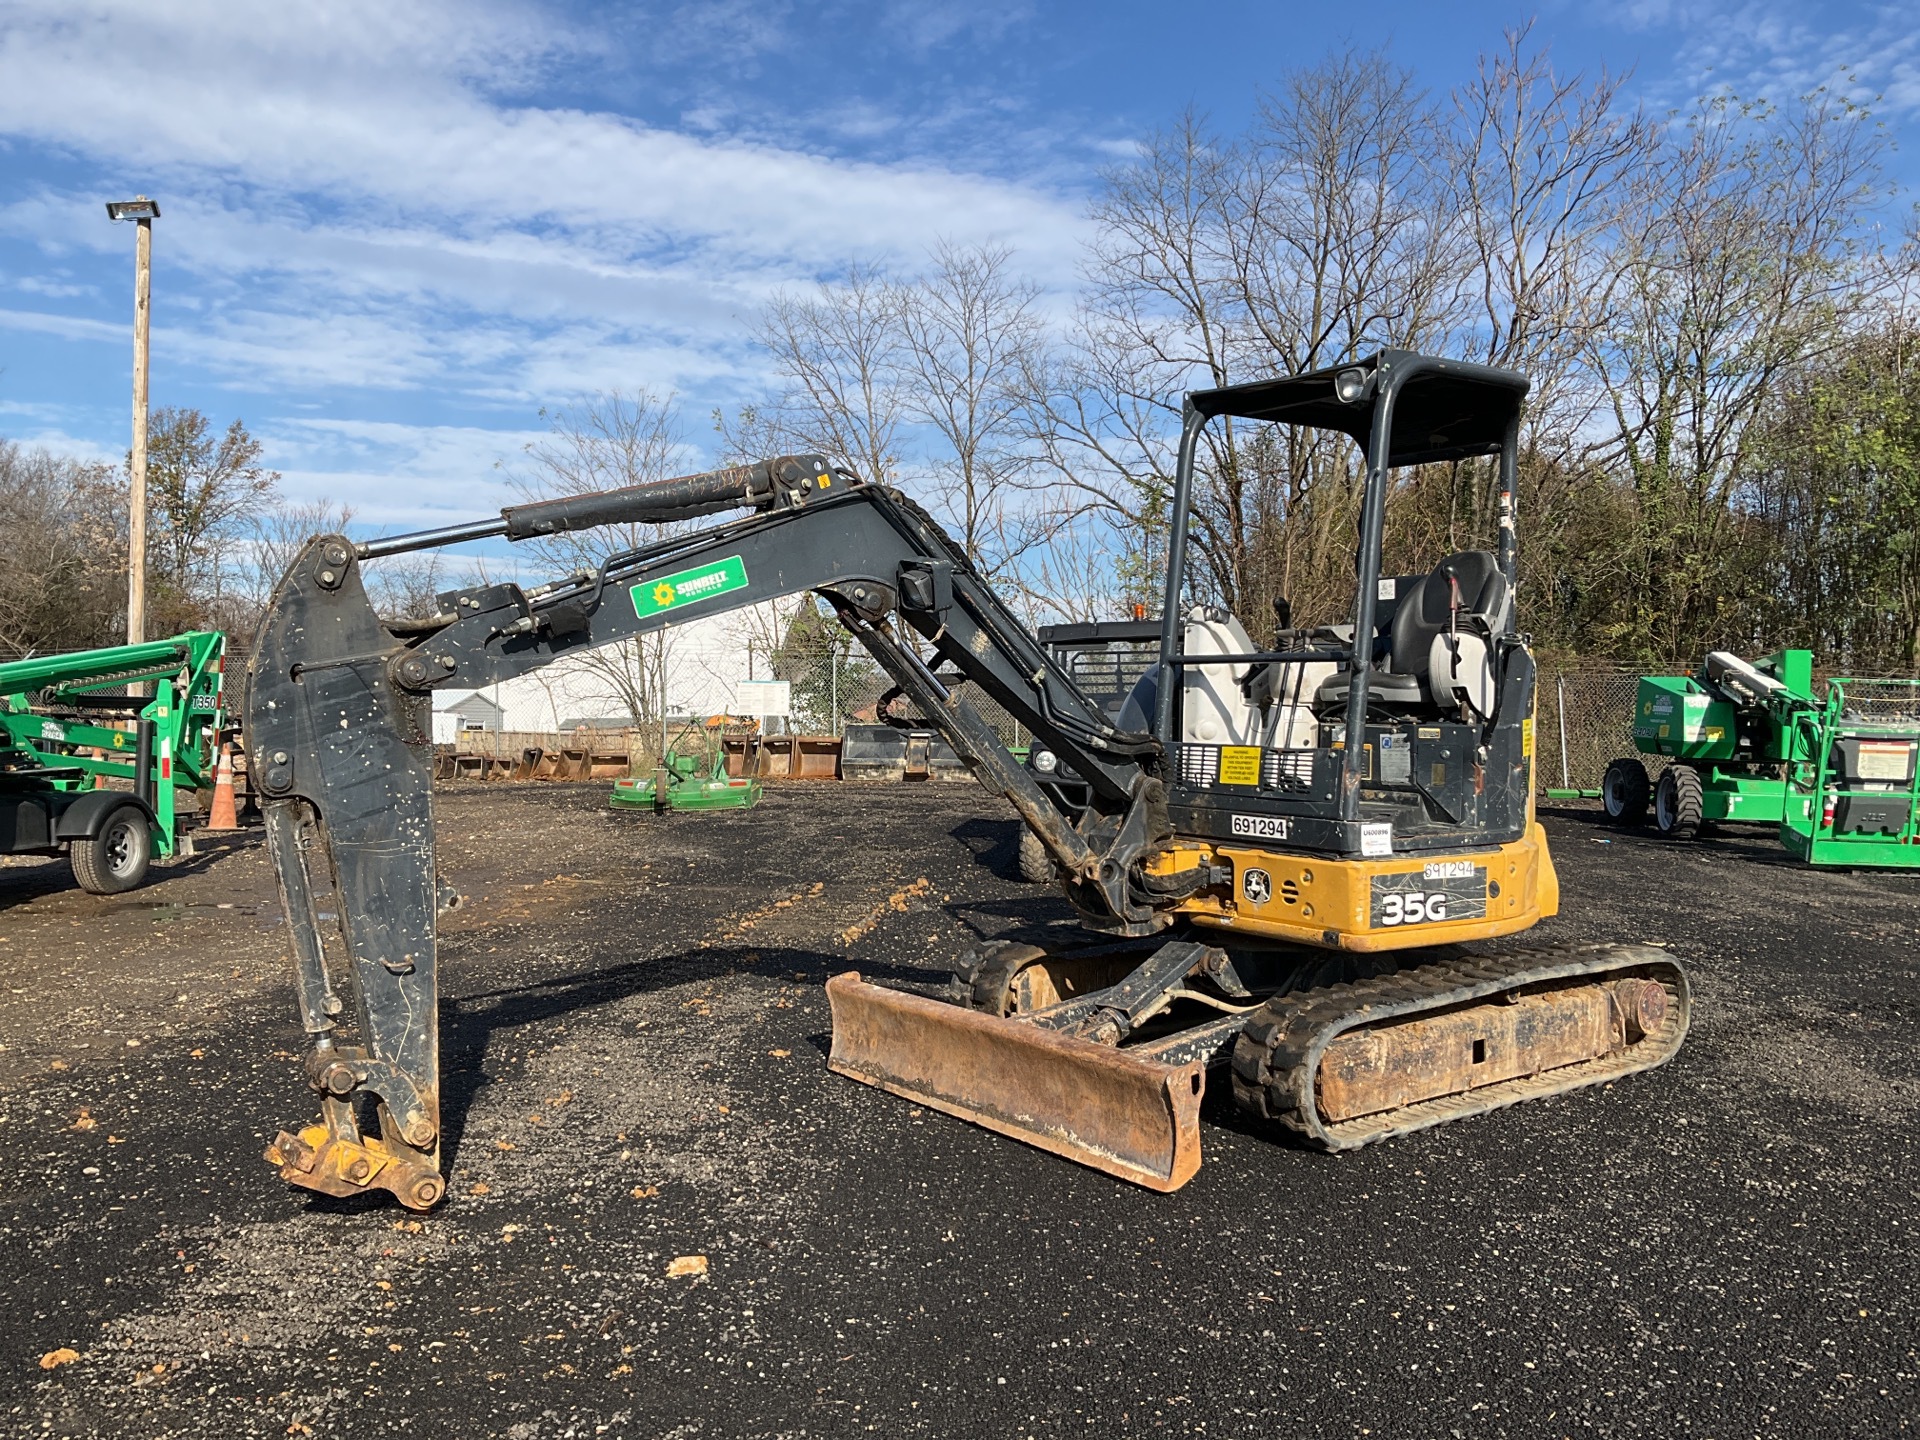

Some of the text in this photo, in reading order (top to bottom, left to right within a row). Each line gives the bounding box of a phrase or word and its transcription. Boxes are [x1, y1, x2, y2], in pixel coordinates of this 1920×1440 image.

[675, 570, 727, 595] SUNBELT
[686, 583, 722, 598] RENTALS
[192, 694, 216, 710] T350
[1234, 817, 1285, 837] 691294
[1424, 861, 1473, 878] 691294
[1382, 892, 1446, 926] 35G
